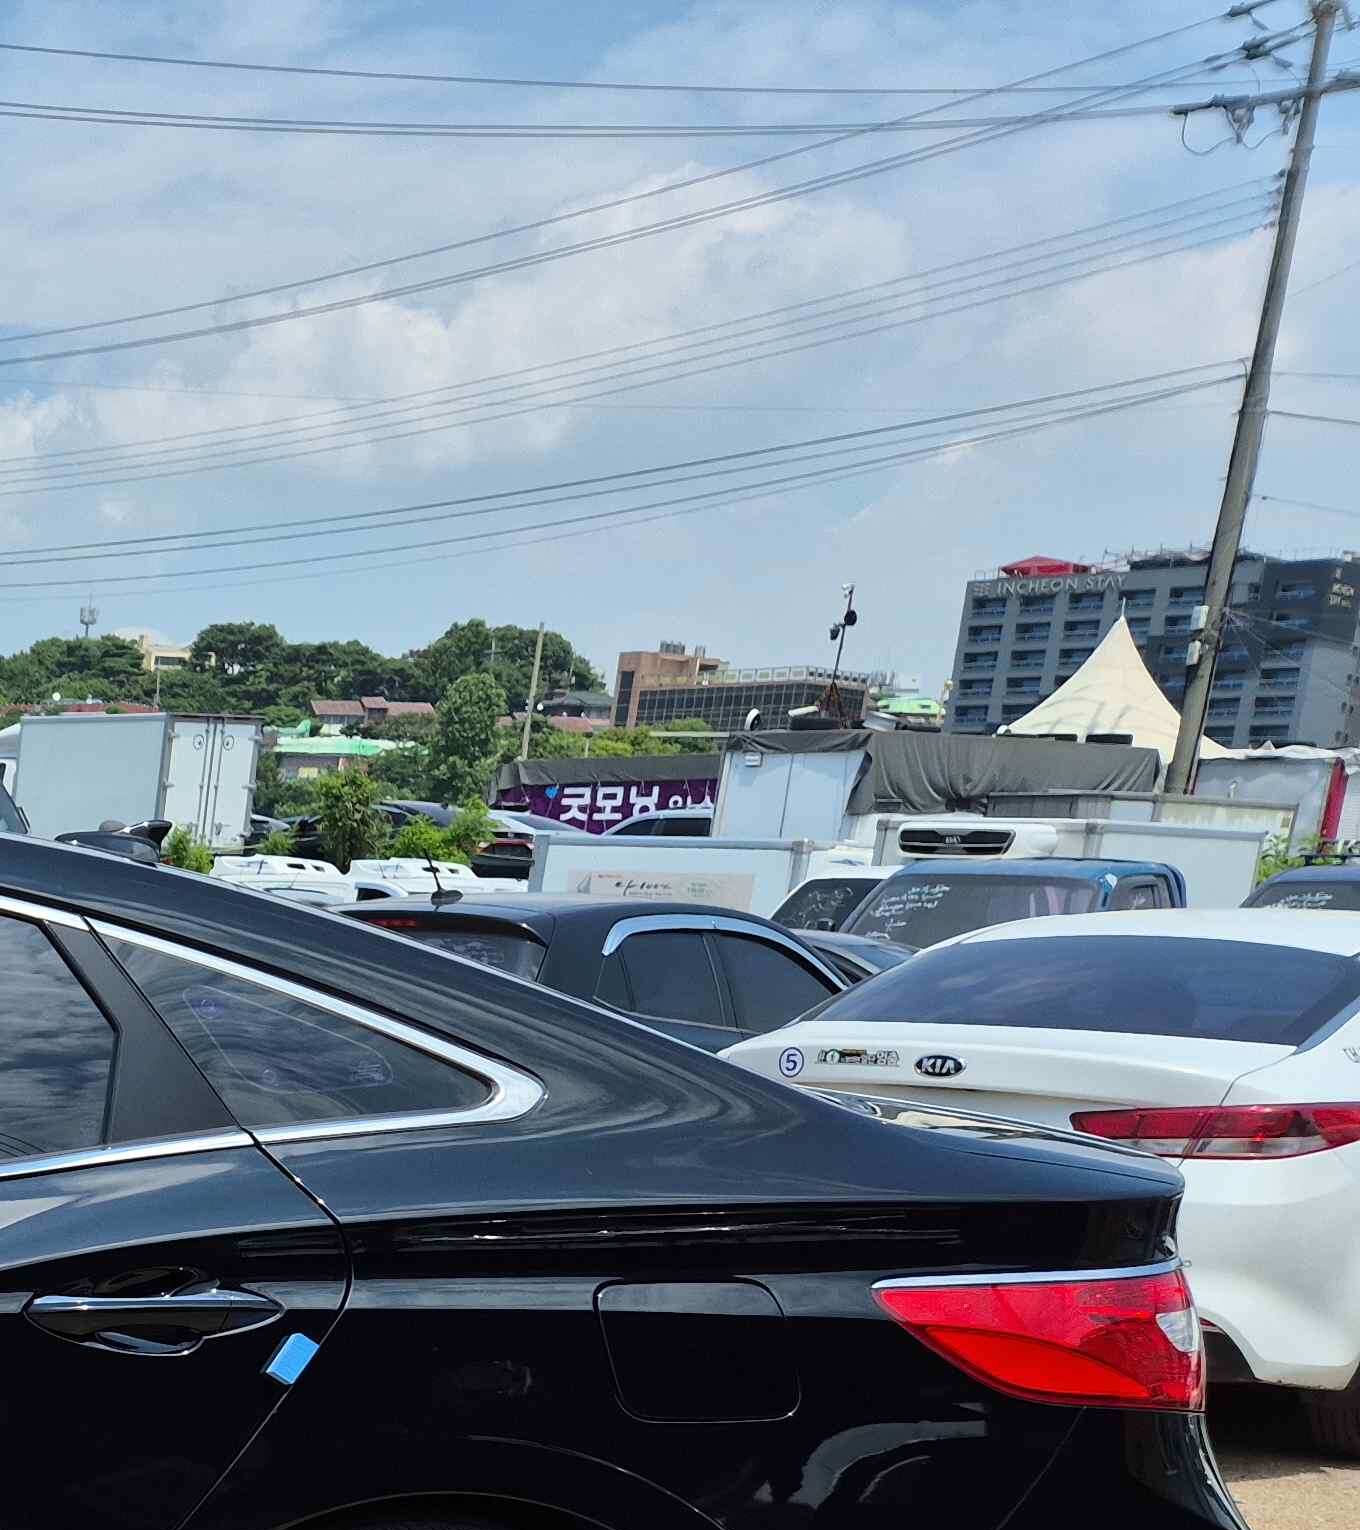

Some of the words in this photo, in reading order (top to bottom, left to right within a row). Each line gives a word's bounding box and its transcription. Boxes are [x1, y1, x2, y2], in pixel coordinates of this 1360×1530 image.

[996, 576, 1079, 595] INCHEON
[1085, 574, 1126, 592] STAY
[784, 1053, 799, 1072] 5
[920, 1059, 957, 1074] KIA
